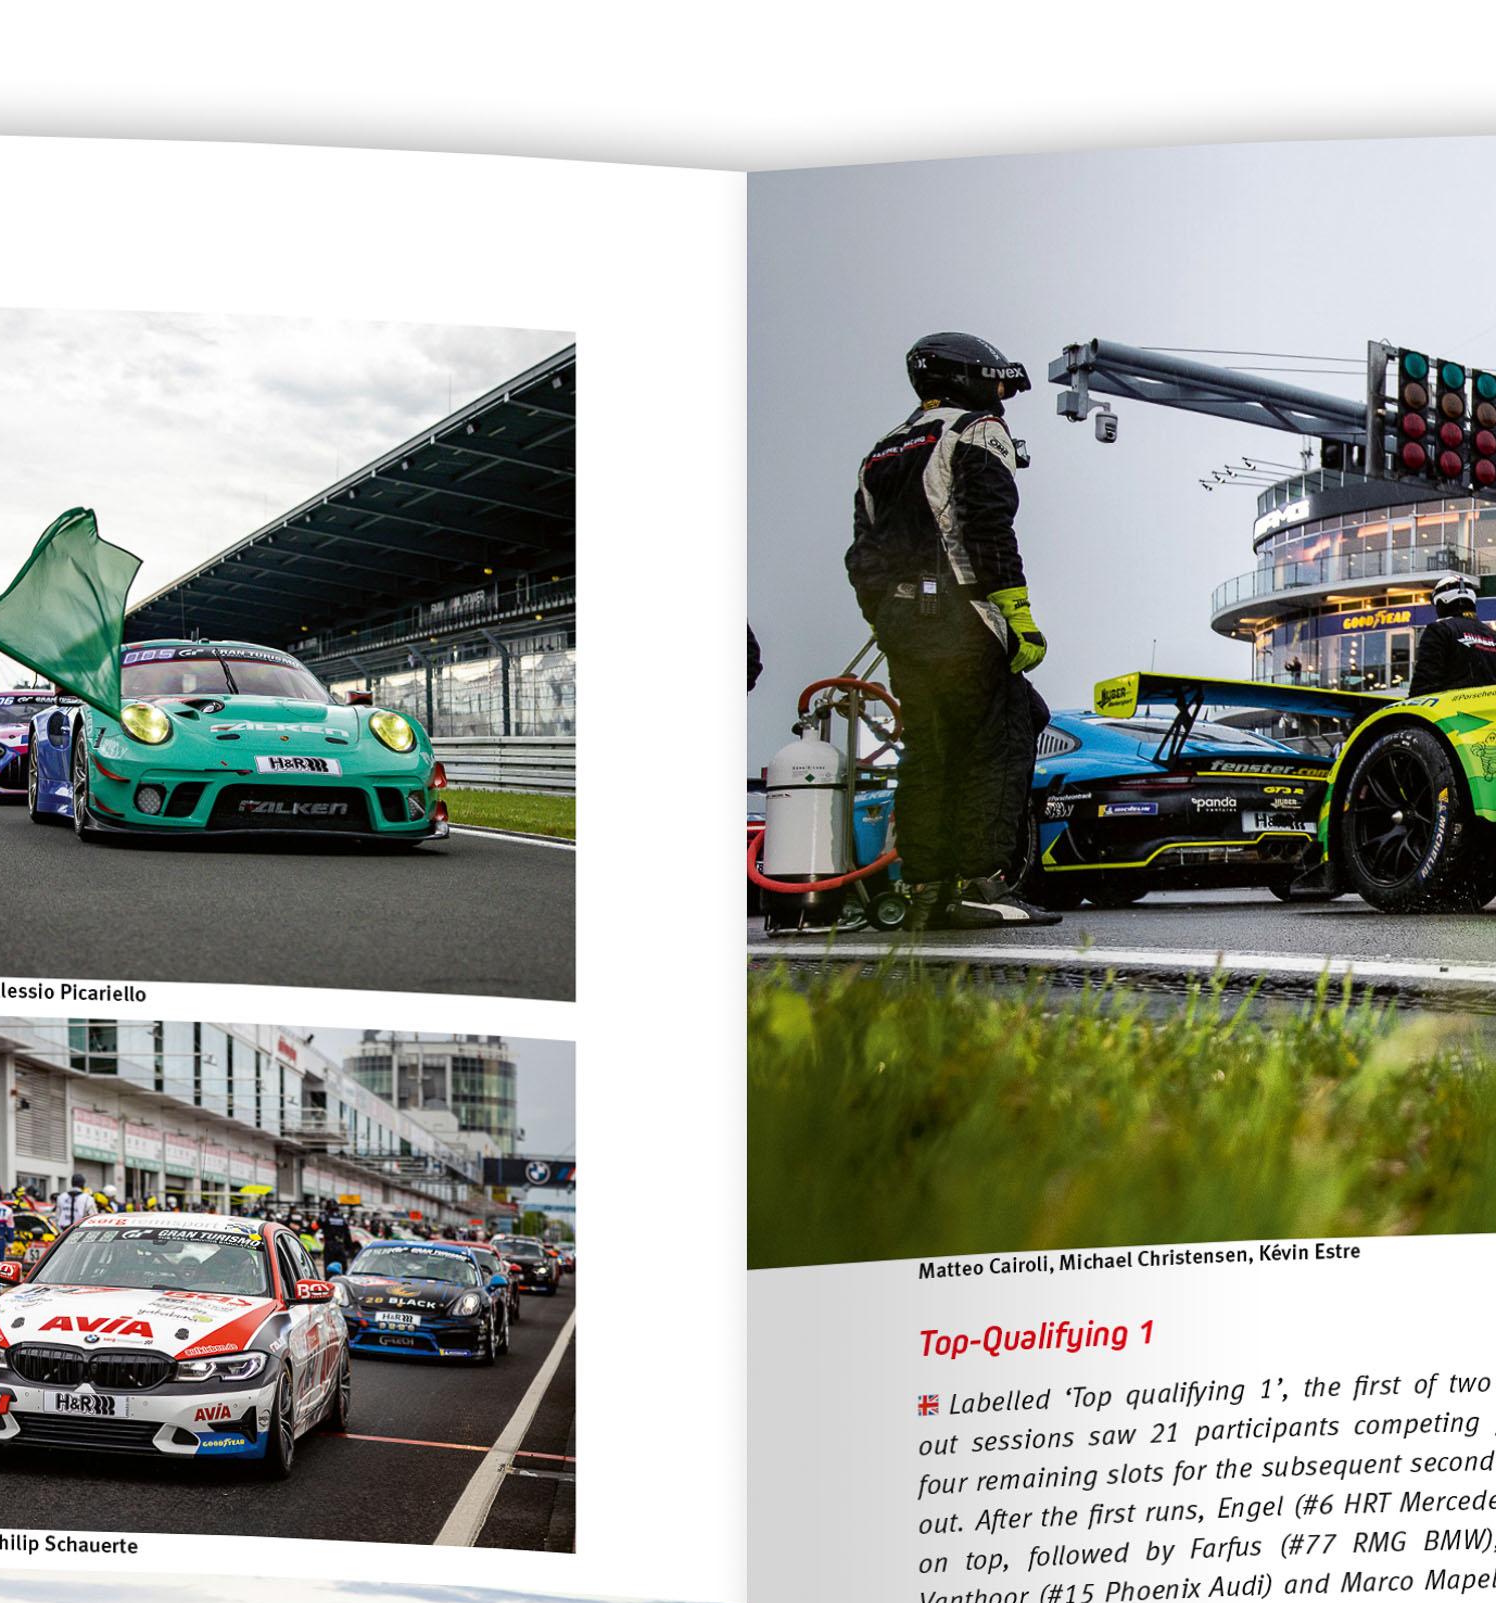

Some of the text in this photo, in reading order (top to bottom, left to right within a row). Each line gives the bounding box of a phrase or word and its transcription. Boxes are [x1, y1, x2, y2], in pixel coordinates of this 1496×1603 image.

[981, 366, 1025, 380] uvex
[1343, 609, 1412, 630] GOODYEAR
[239, 798, 349, 816] FALKEN
[1195, 797, 1237, 812] panda
[1421, 814, 1446, 879] MICHELIN
[61, 983, 146, 1002] Picariello
[158, 1229, 198, 1240] GRAN
[200, 1231, 261, 1248] TURISMO
[918, 1241, 1361, 1280] Matteo Cairoli, Michael Christensen, Kévin Estre
[388, 1297, 437, 1309] BLACK
[920, 1319, 1153, 1360] Top-Qualifying 1
[948, 1387, 1052, 1416] Labelled
[1125, 1379, 1245, 1411] qualifying
[1304, 1376, 1342, 1398] the
[1352, 1374, 1403, 1402] first
[1413, 1372, 1440, 1400] of
[1449, 1373, 1492, 1394] two
[202, 1437, 245, 1447] GOODYEAR
[45, 1535, 138, 1554] Schauerte
